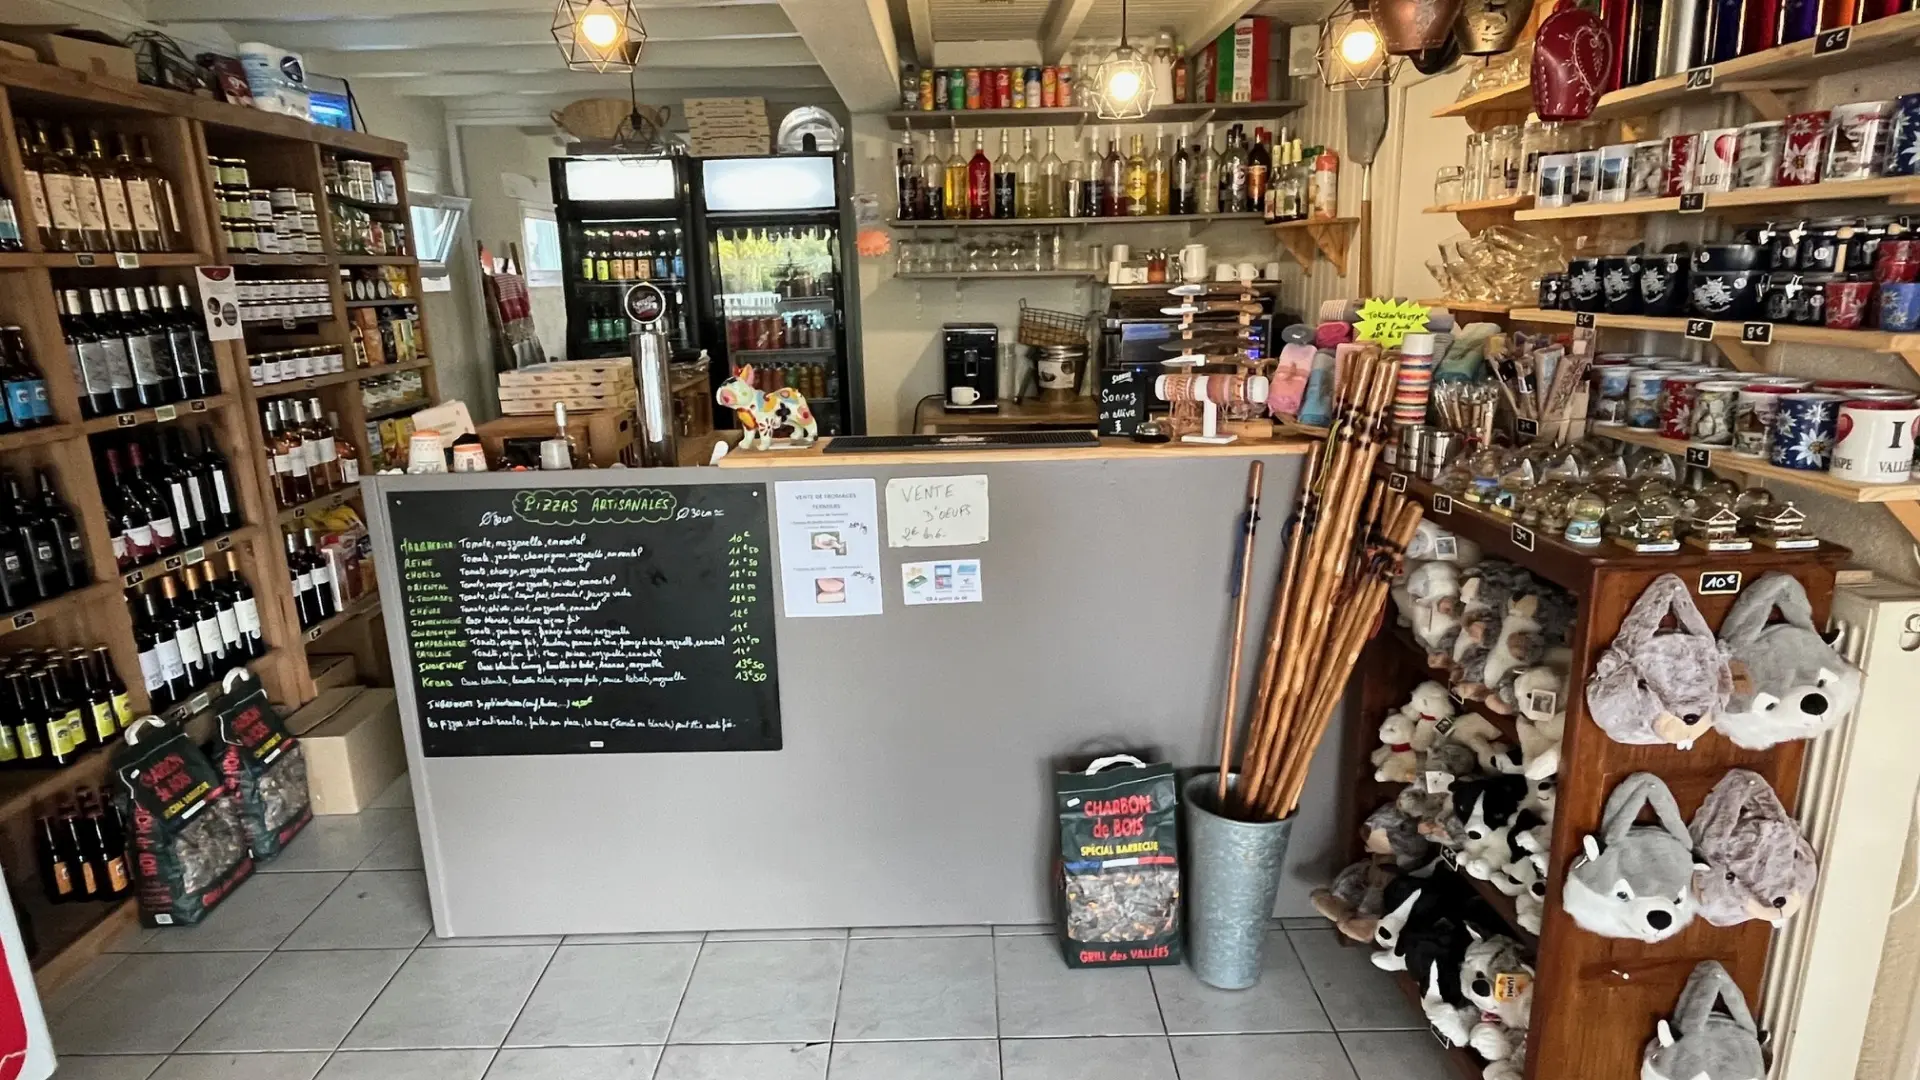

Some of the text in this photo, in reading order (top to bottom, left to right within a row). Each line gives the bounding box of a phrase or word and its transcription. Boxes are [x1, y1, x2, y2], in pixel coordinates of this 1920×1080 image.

[1826, 31, 1845, 48] 6€
[1746, 326, 1764, 339] 8€
[1102, 388, 1137, 406] Sonnez
[1888, 421, 1906, 449] I
[795, 493, 814, 501] VENTE
[824, 492, 857, 500] FROMAGES
[902, 484, 954, 503] VENTE
[1705, 574, 1736, 588] 10€
[735, 657, 766, 670] 13€50
[734, 669, 769, 683] 13€50
[1084, 794, 1153, 818] CHARBON
[1092, 815, 1145, 839] de BOIS
[1115, 841, 1159, 855] BARBECUE
[1079, 947, 1107, 963] GRILL
[1109, 948, 1128, 961] des
